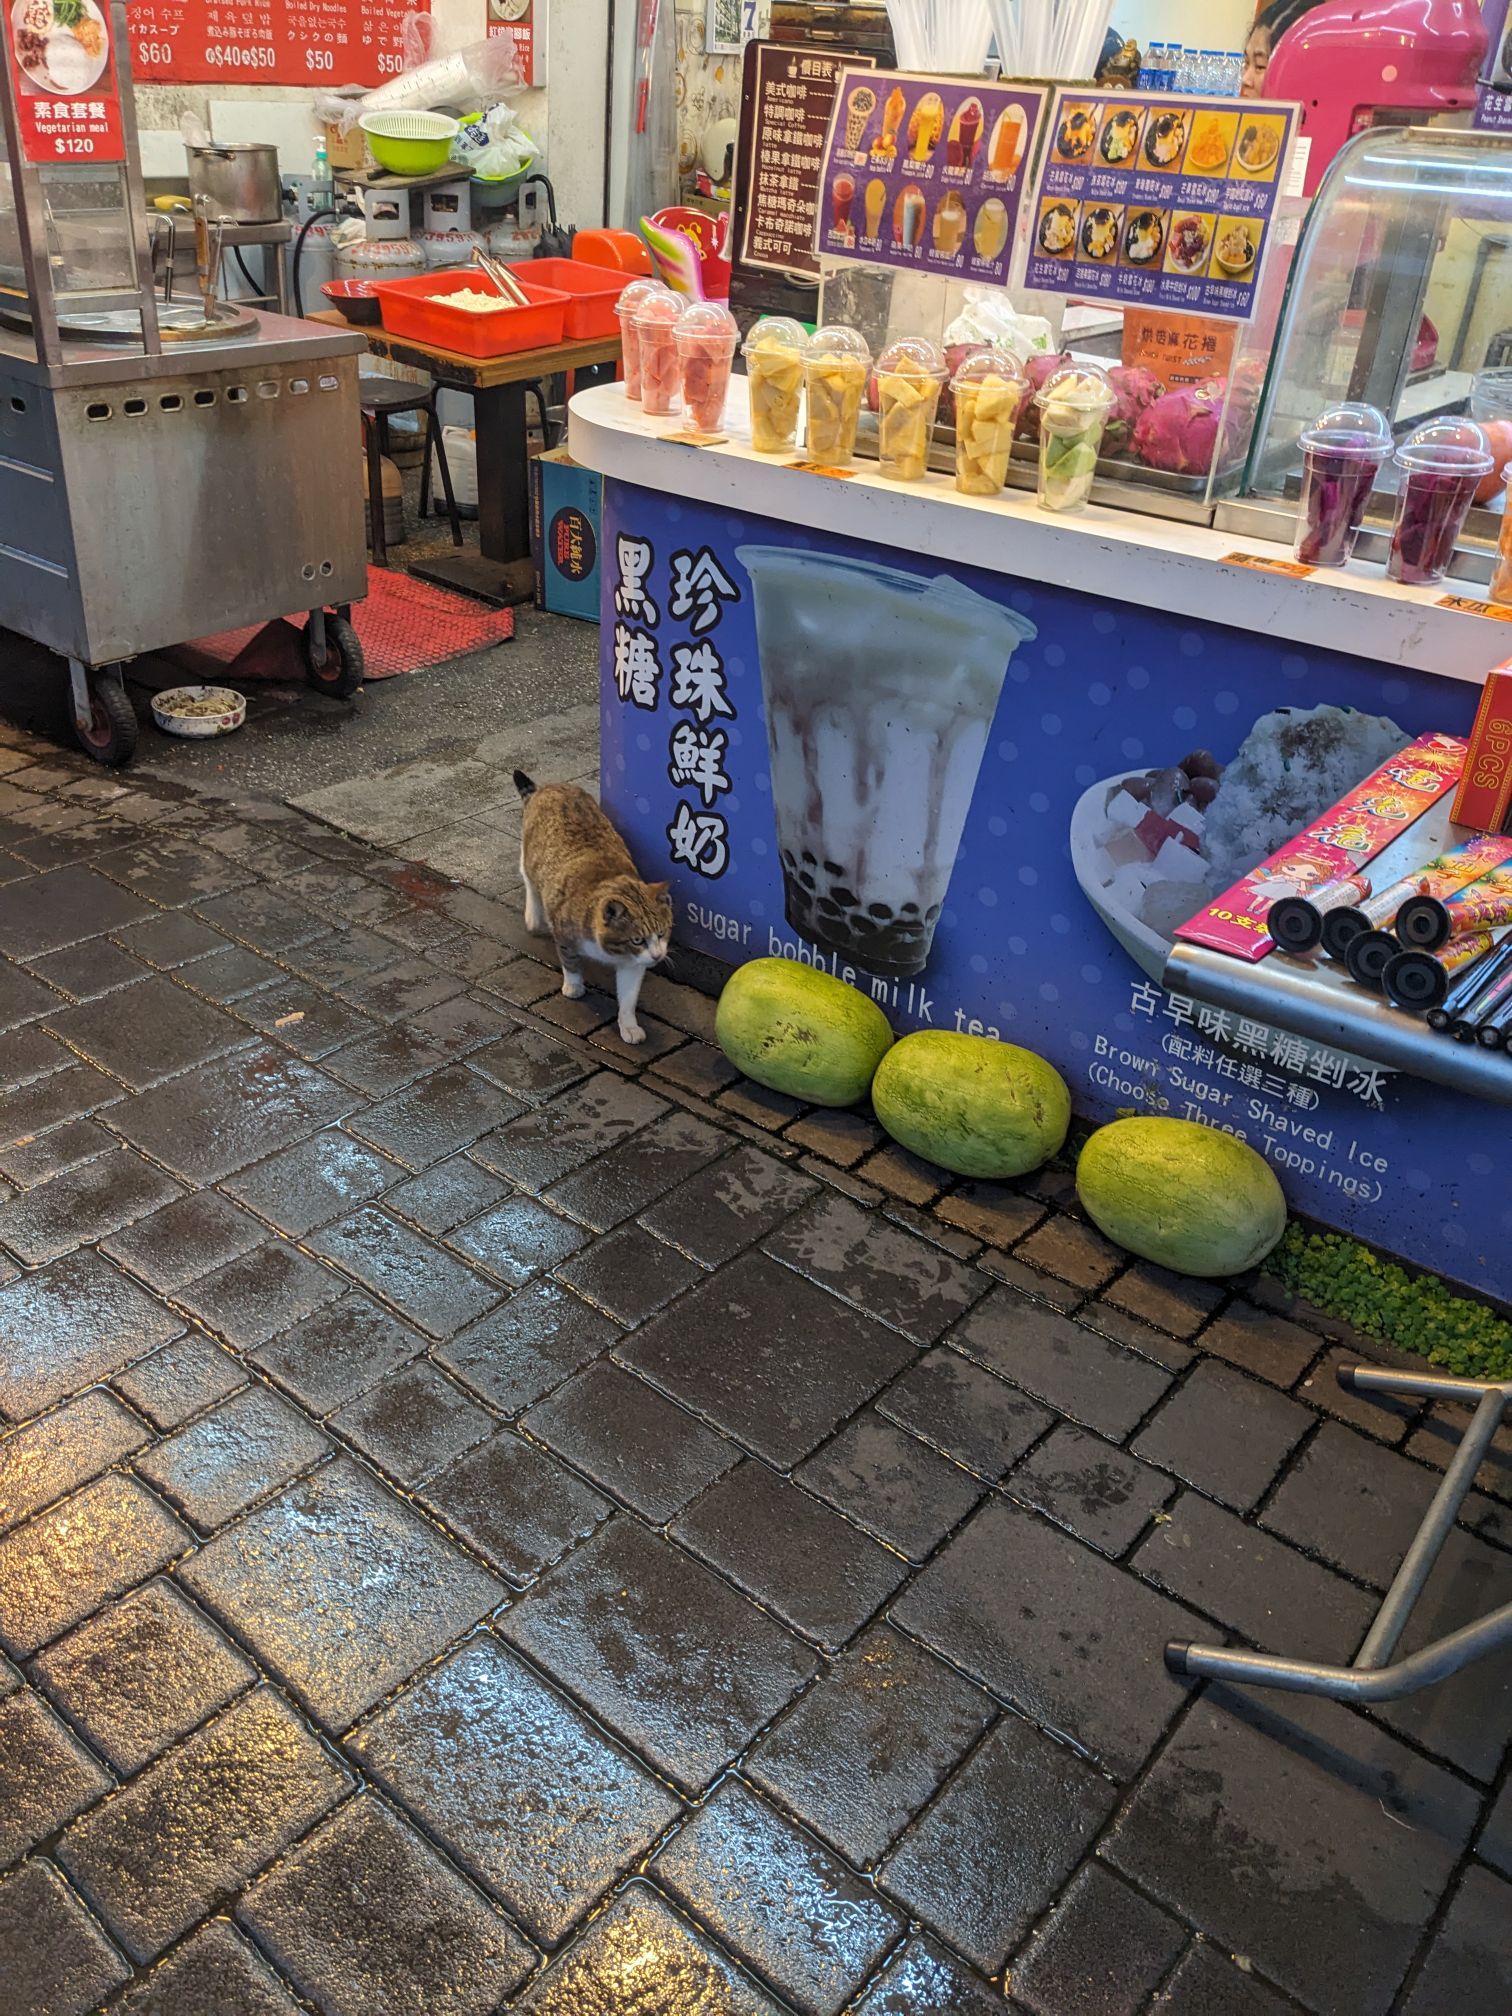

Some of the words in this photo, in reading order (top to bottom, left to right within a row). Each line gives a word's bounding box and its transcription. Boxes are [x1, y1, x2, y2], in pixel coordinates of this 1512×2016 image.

[126, 7, 155, 20] 징어
[743, 1, 757, 31] 7
[128, 24, 180, 36] イカスープ
[139, 42, 172, 64] $60
[305, 48, 334, 71] $50
[377, 52, 403, 74] $50
[765, 81, 808, 99] 美式咖啡
[34, 102, 106, 119] 素食套餐
[763, 104, 806, 123] 特調咖啡
[35, 122, 86, 134] Vegetarian
[89, 122, 109, 133] meal
[55, 138, 94, 154] $120
[757, 193, 819, 216] 焦糖瑪奇朵咖
[753, 235, 793, 256] 義式可可
[614, 535, 661, 707] 黑糖
[670, 550, 738, 876] 珍珠鮮奶
[1473, 719, 1512, 789] 6PCS
[687, 902, 752, 945] sugar
[871, 976, 935, 1024] milk
[954, 1007, 1000, 1041] tea
[1130, 980, 1388, 1103] 古早味黑糖剉冰
[1161, 1032, 1321, 1112] (配料任選三種)
[1094, 1034, 1158, 1078] Brown
[1169, 1065, 1233, 1108] Sugar
[1247, 1098, 1334, 1151] Shaved
[1347, 1140, 1389, 1174] Ice
[1087, 1061, 1170, 1112] (Choose
[1183, 1100, 1248, 1144] Three
[1262, 1134, 1384, 1204] Toppings)
